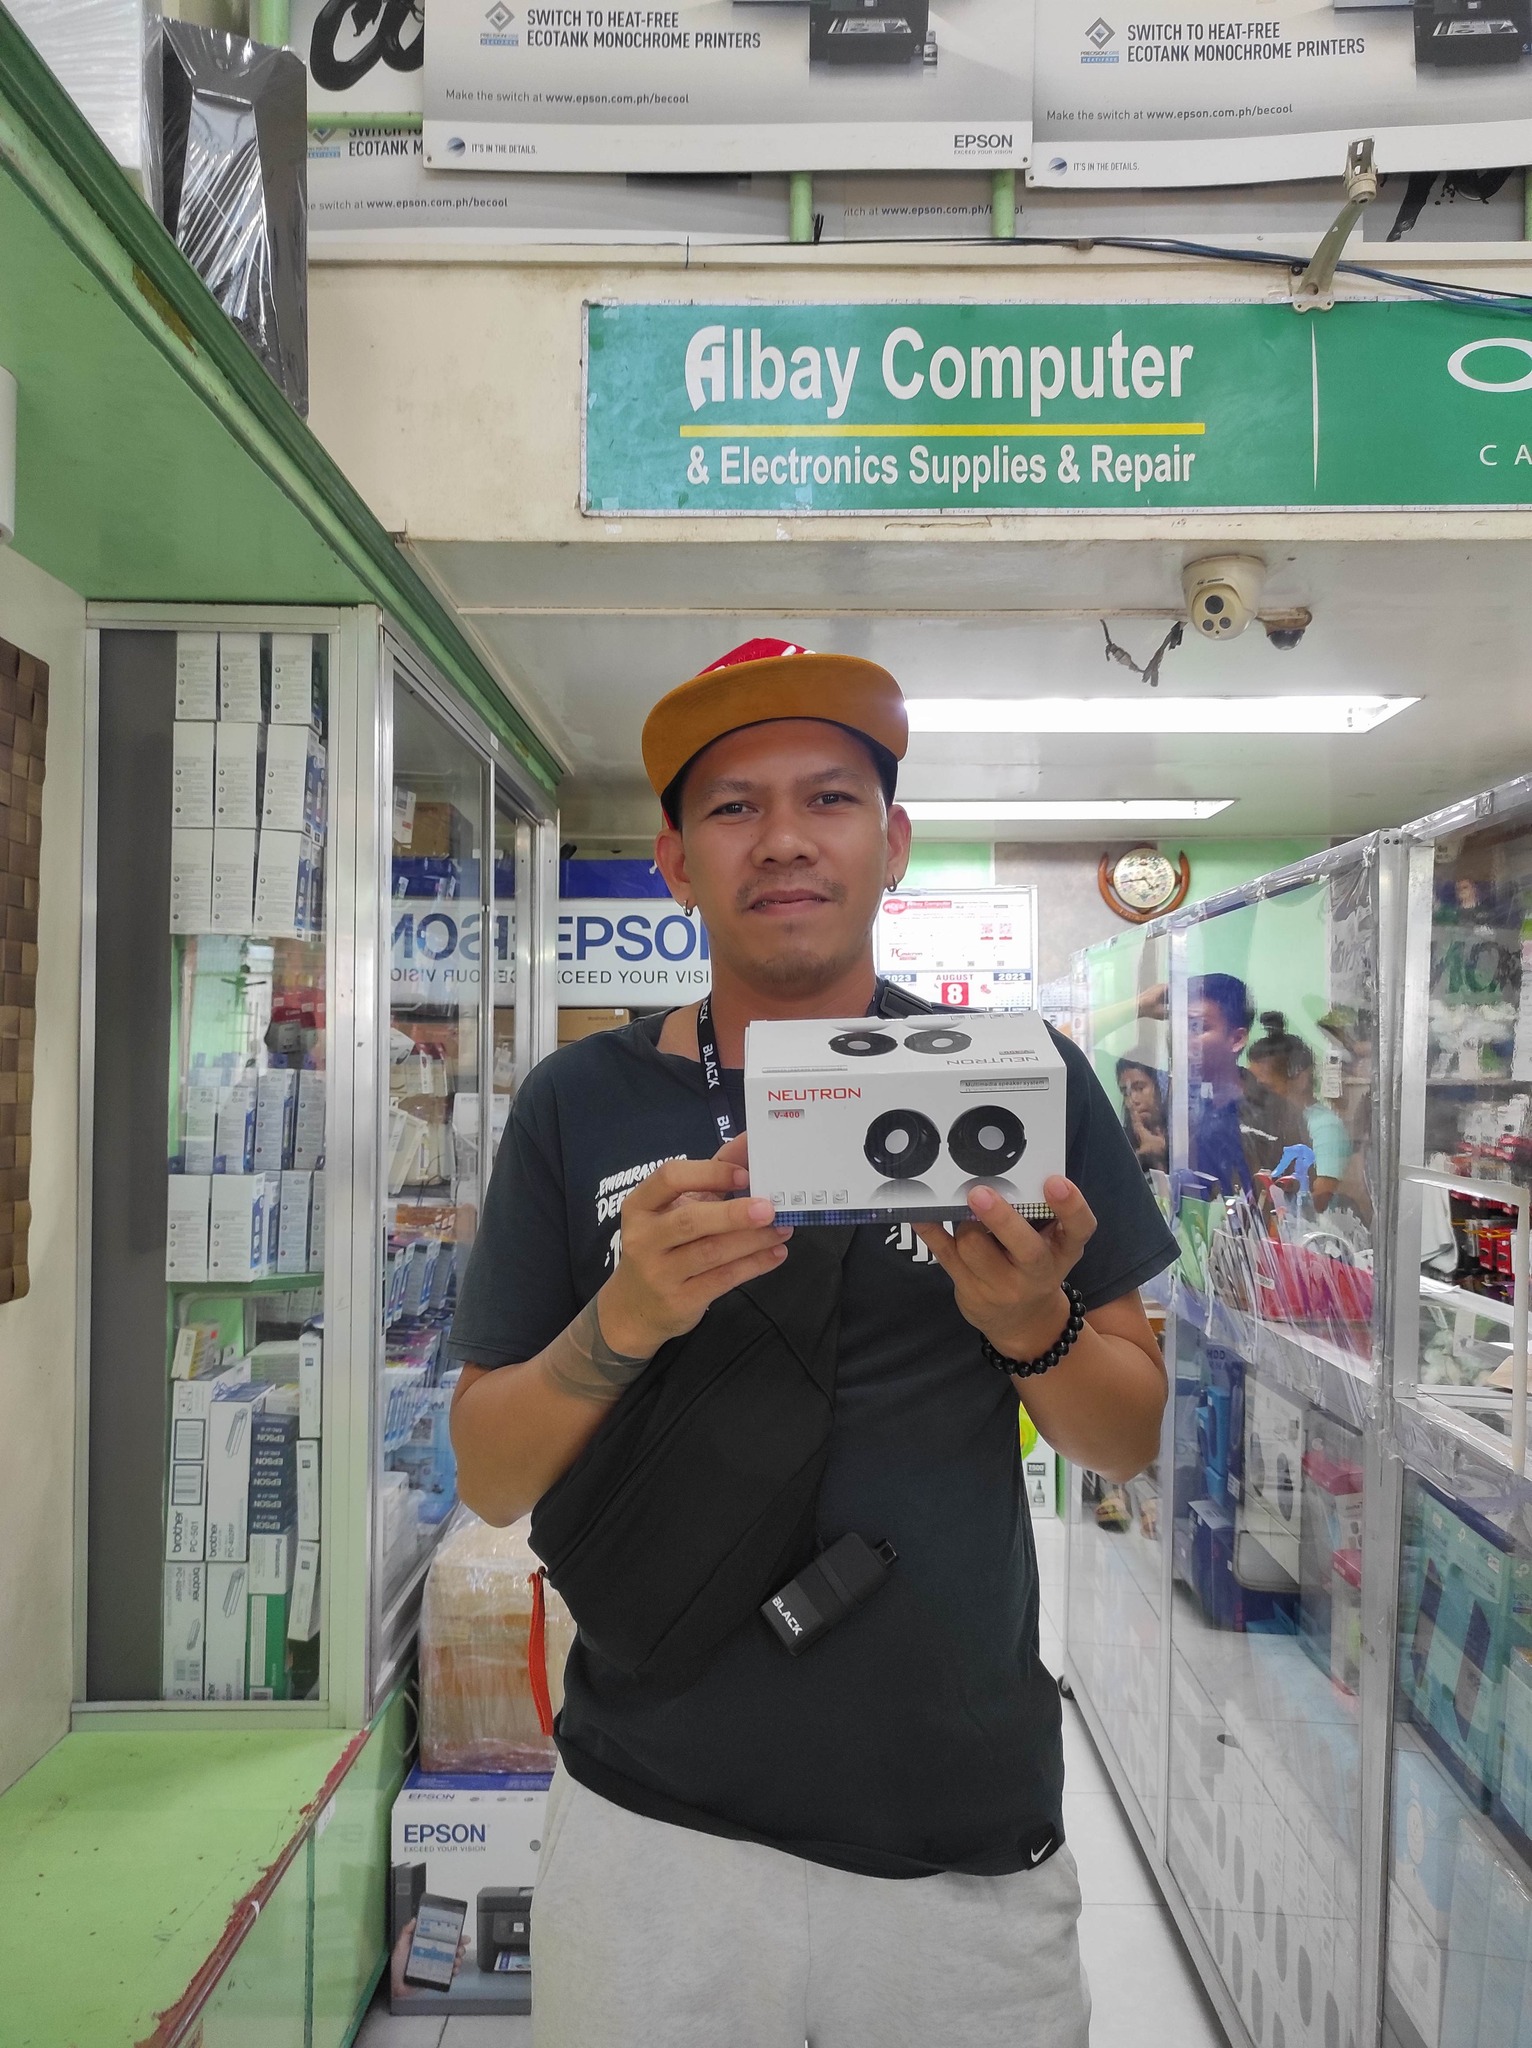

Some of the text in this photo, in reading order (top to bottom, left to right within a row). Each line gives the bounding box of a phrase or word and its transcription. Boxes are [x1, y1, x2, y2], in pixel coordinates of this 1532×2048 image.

[527, 9, 679, 28] SWITCH TO HEAT-FREE
[527, 30, 589, 48] ECOTANK
[593, 31, 690, 49] MONOCHROME
[695, 32, 761, 49] PRINTERS
[1127, 22, 1280, 41] SWITCH TO HEAT-FREE
[1127, 38, 1365, 63] ECOTANK MONOCHROME PRINTERS
[446, 89, 689, 106] Make the switch at www.epson.com.ph/becool
[1046, 103, 1293, 122] Make the switch at www.epson.com.ph/becool
[349, 140, 409, 157] ECOTANK
[471, 143, 486, 153] IT'S
[487, 144, 493, 153] IN
[494, 144, 508, 153] THE
[953, 134, 1013, 149] EPSON
[1073, 163, 1086, 171] IT'S
[1087, 163, 1095, 171] IN
[1097, 163, 1109, 171] THE
[319, 200, 351, 211] switch
[354, 201, 364, 210] at
[366, 198, 508, 211] www.epson.com.ph/becool
[869, 207, 878, 216] at
[684, 324, 1194, 420] Albay Computer
[687, 442, 1196, 493] & Electronics Supplies & Repair
[618, 970, 668, 984] YOUR
[675, 970, 710, 984] VISI
[936, 973, 974, 982] AUGUST
[998, 972, 1026, 982] 2023
[947, 984, 963, 1005] 8
[702, 1043, 720, 1090] BLACK
[946, 1056, 1040, 1066] NEUTRON
[767, 1087, 862, 1102] NEUTRON
[773, 1110, 800, 1119] V-400
[256, 1433, 286, 1443] EPSON
[255, 1457, 284, 1466] EPSON
[253, 1477, 282, 1487] EPSON
[253, 1499, 282, 1508] EPSON
[172, 1510, 184, 1553] brother
[252, 1520, 281, 1530] EPSON
[189, 1520, 199, 1553] PC-501
[209, 1522, 218, 1558] brother
[192, 1566, 201, 1602] brother
[771, 1595, 803, 1637] BLACK
[408, 1793, 455, 1801] EPSON
[404, 1823, 486, 1843] EPSON
